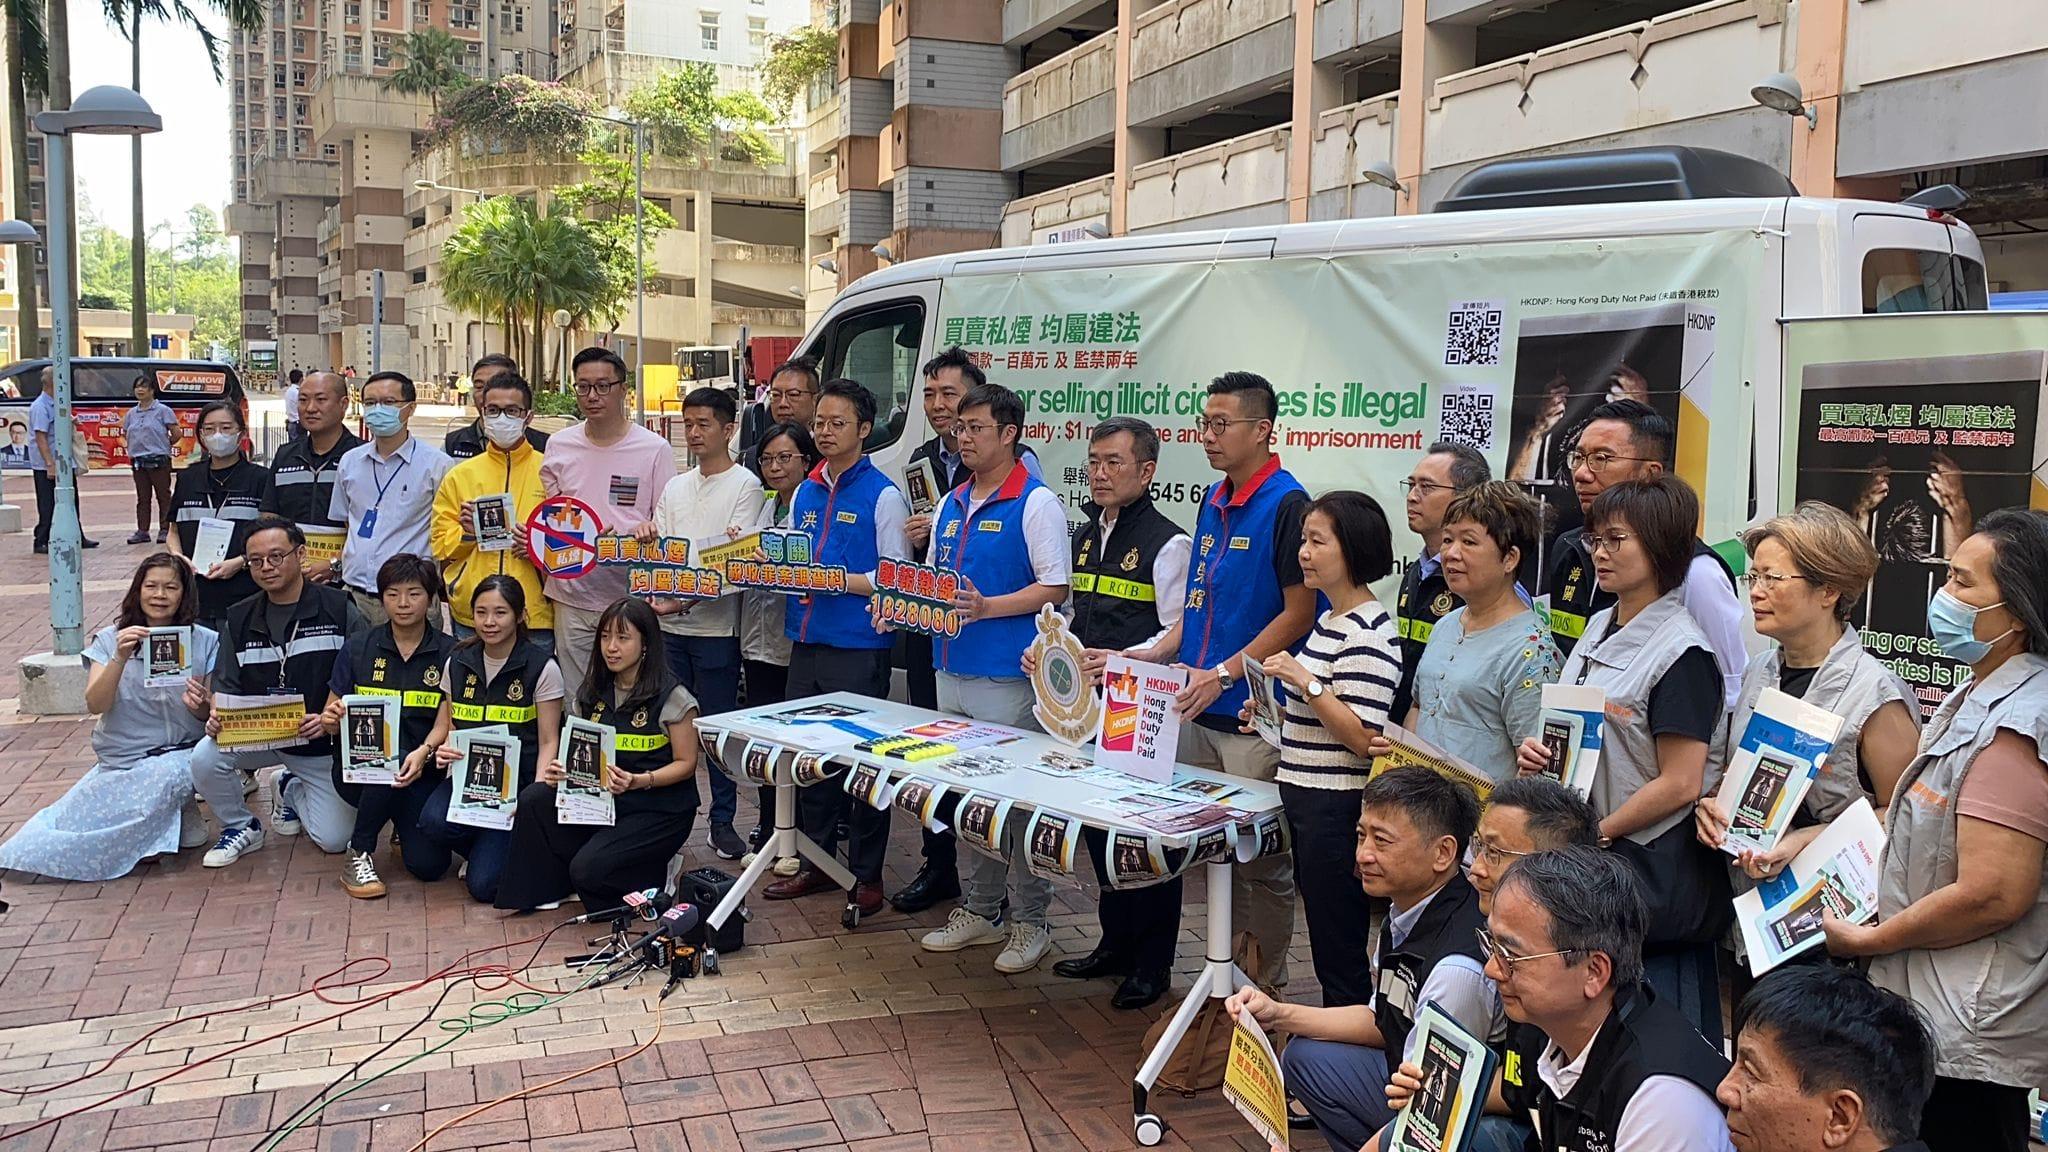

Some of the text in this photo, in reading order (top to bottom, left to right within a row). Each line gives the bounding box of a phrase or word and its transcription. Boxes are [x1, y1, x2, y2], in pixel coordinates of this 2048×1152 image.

[1556, 296, 1576, 306] Hong
[1578, 295, 1599, 306] Kong
[1600, 293, 1619, 305] Duty
[1622, 294, 1637, 303] Not
[1639, 292, 1657, 303] Paid
[943, 311, 1141, 347] 買賣私煙 均屬違法
[1687, 312, 1716, 331] HKDNP
[1054, 351, 1068, 370] 及
[1074, 350, 1138, 370] 監禁兩年
[174, 375, 224, 384] LALAMOVE
[1039, 382, 1114, 421] selling
[1117, 382, 1171, 415] illicit
[1312, 383, 1336, 417] is
[1341, 382, 1428, 428] illegal
[1819, 403, 2017, 430] 買賣私煙 均屬違法
[1065, 421, 1082, 442] $1
[1286, 427, 1423, 451] imprisonment
[1818, 427, 2016, 447] 最高罰款一百萬元 及 監禁兩年
[597, 537, 688, 565] 買賣私煙
[762, 530, 811, 563] 海關
[556, 549, 582, 566] 私煙
[629, 568, 722, 598] 均屬違法
[727, 562, 846, 592] 稅收罪案調查科
[877, 559, 959, 602] 舉報熱線
[1561, 565, 1583, 602] 海關
[1109, 580, 1140, 597] RCIB
[871, 593, 961, 637] 1828080
[1894, 634, 1916, 653] or
[372, 657, 388, 683] 海關
[1932, 662, 1953, 685] is
[463, 673, 478, 700] 海關
[1146, 676, 1181, 694] HKDNP
[1143, 694, 1167, 711] Hong
[499, 708, 529, 720] RCIB
[1112, 715, 1136, 730] HKDNP
[1142, 709, 1164, 725] Kong
[1140, 720, 1161, 736] Duty
[621, 734, 656, 749] RCIB
[1138, 732, 1154, 746] Not
[1137, 745, 1156, 760] Paid
